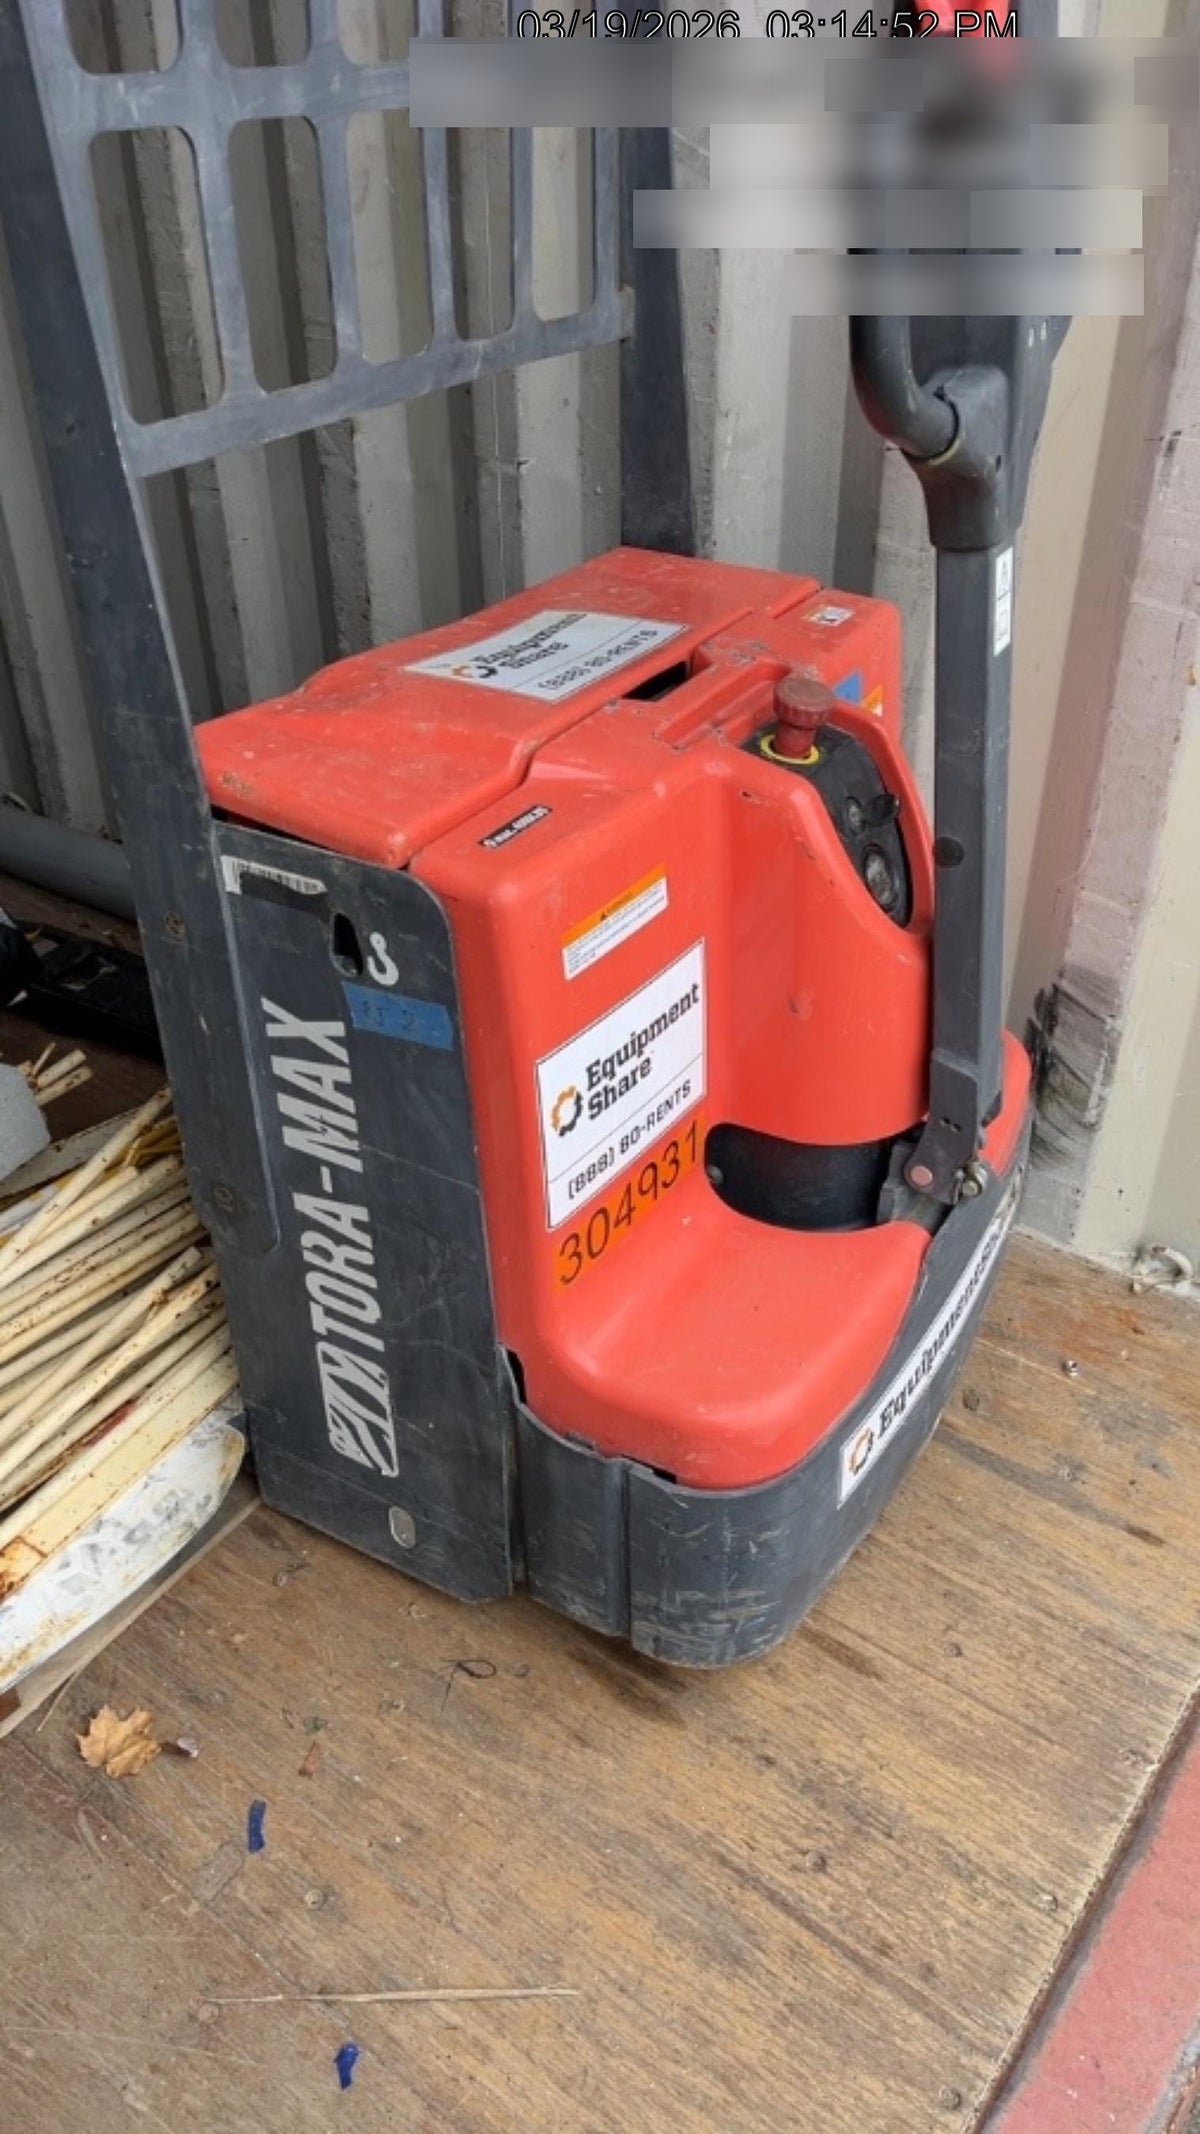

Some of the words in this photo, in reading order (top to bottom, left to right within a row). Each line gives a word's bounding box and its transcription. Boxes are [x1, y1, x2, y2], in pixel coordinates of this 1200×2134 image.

[584, 981, 700, 1092] Equipment
[587, 1056, 652, 1121] Share
[619, 1079, 692, 1156] 80-RENTS
[260, 997, 386, 1352] TORA-MAX
[559, 1119, 700, 1287] 304931
